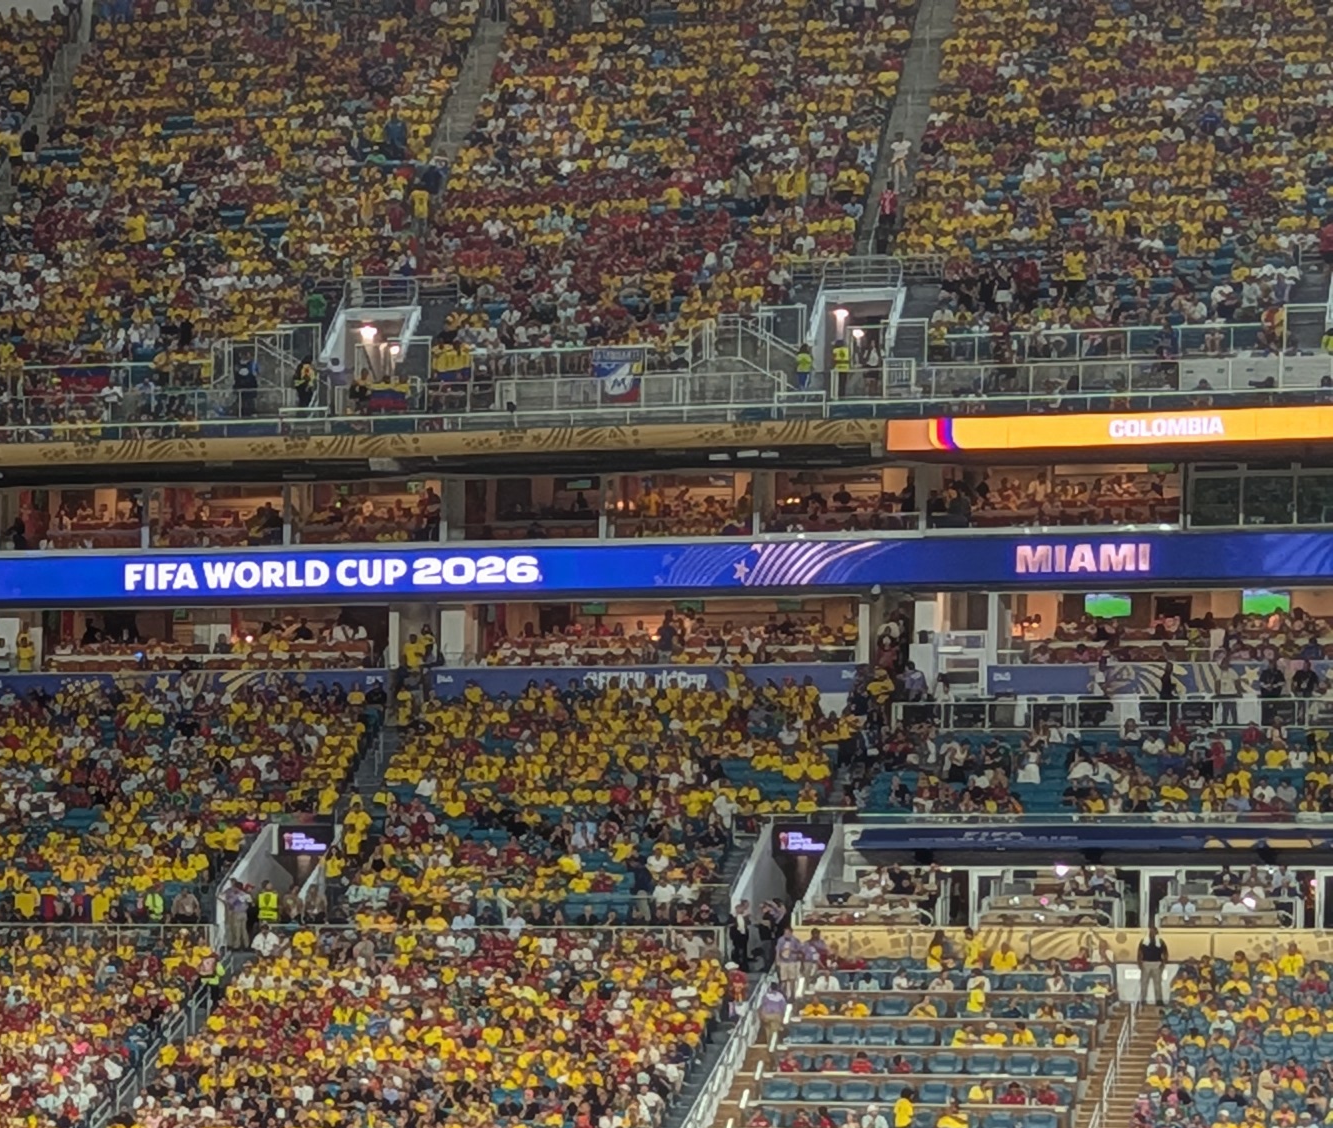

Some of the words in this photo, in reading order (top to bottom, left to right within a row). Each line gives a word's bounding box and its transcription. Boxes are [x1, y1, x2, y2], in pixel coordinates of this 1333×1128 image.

[1109, 416, 1224, 438] COLOMBIA
[124, 562, 198, 590] FIFA
[202, 559, 331, 589] WORLD
[336, 558, 408, 588] CUP
[413, 555, 541, 585] 2026
[1016, 543, 1151, 573] MIAMI
